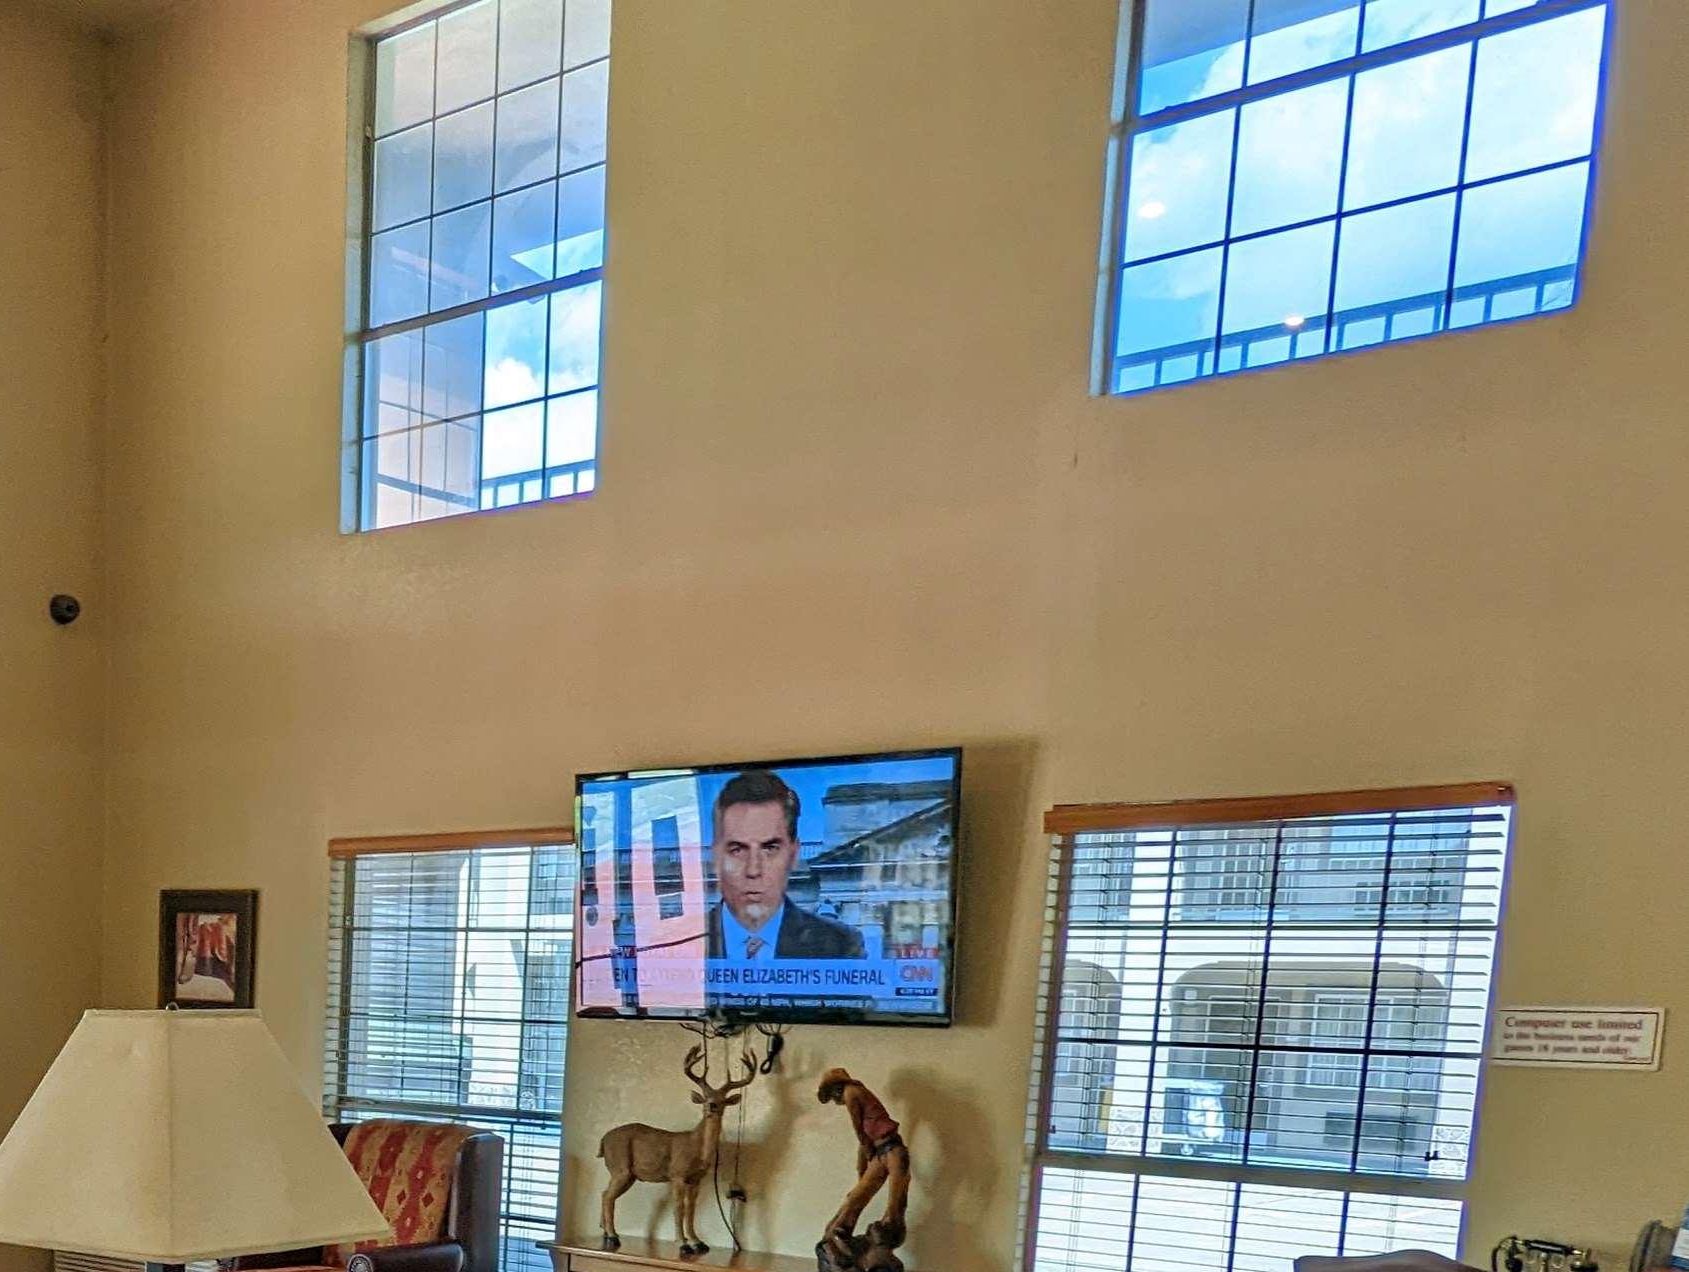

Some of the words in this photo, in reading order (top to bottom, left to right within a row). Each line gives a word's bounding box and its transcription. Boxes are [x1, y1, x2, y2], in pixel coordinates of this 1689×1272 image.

[742, 968, 821, 985] ELIZABETH'S
[825, 969, 886, 985] FUNERAL
[1571, 1021, 1593, 1029] use
